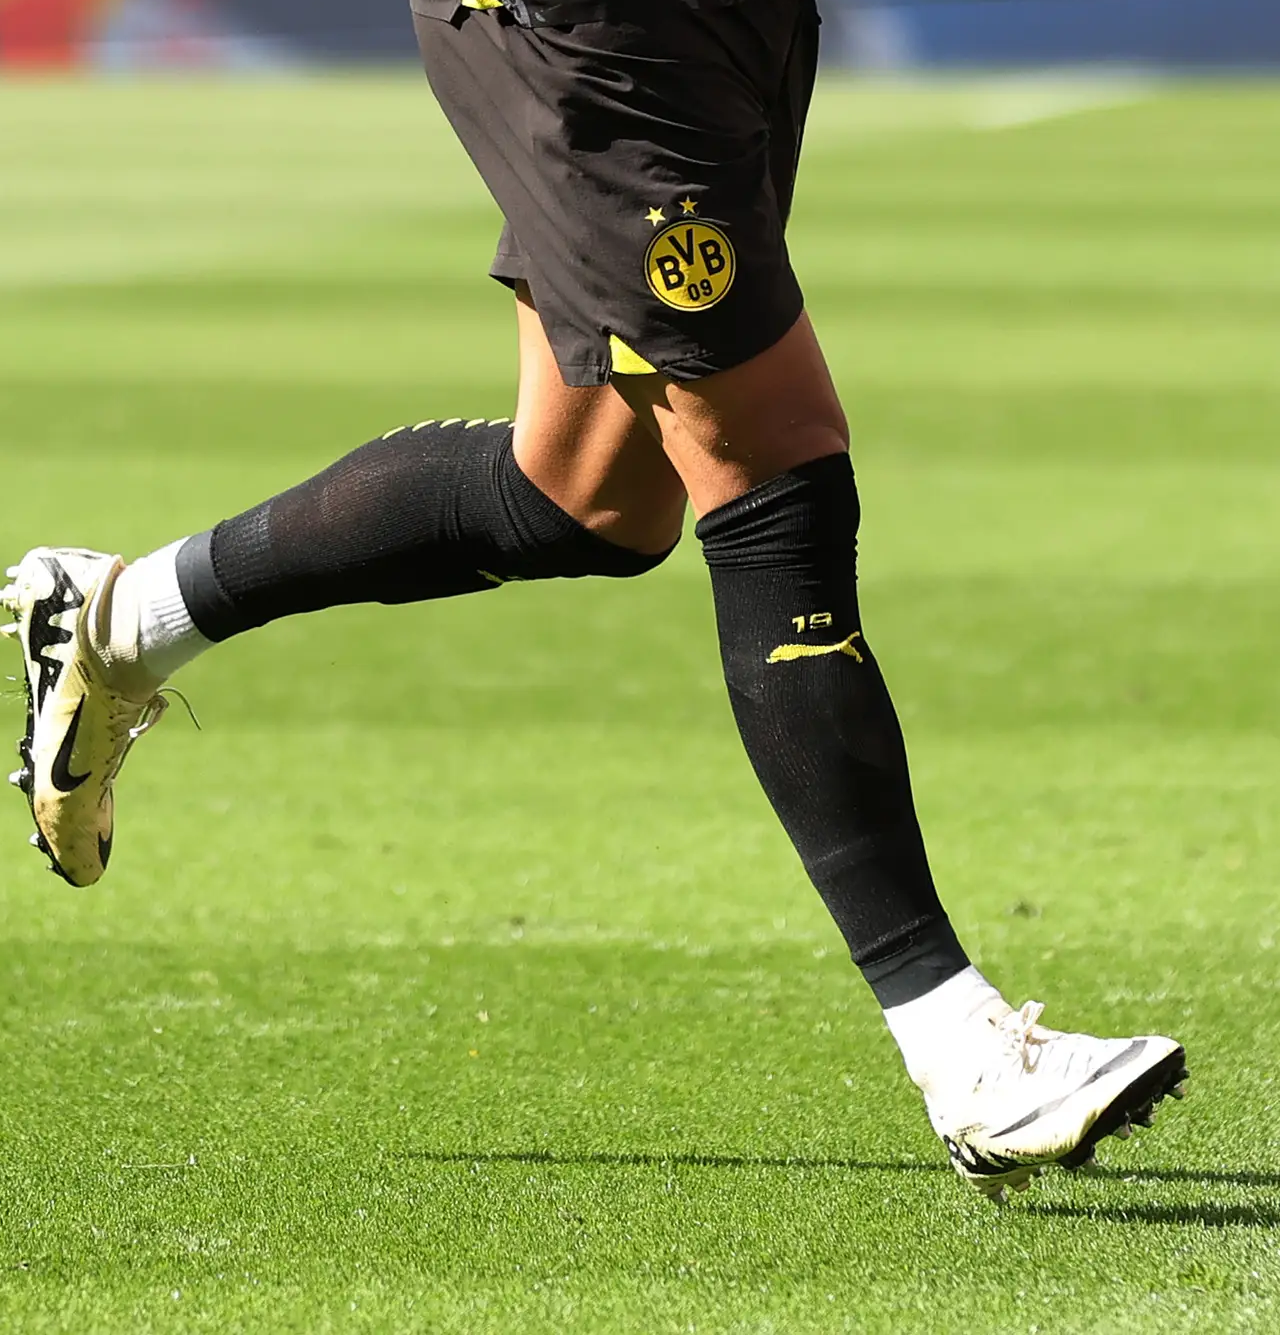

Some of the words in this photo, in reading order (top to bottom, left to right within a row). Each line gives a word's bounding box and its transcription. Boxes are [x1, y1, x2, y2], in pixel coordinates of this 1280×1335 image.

[656, 228, 725, 291] BVB
[687, 279, 713, 301] 09
[792, 612, 833, 633] 19
